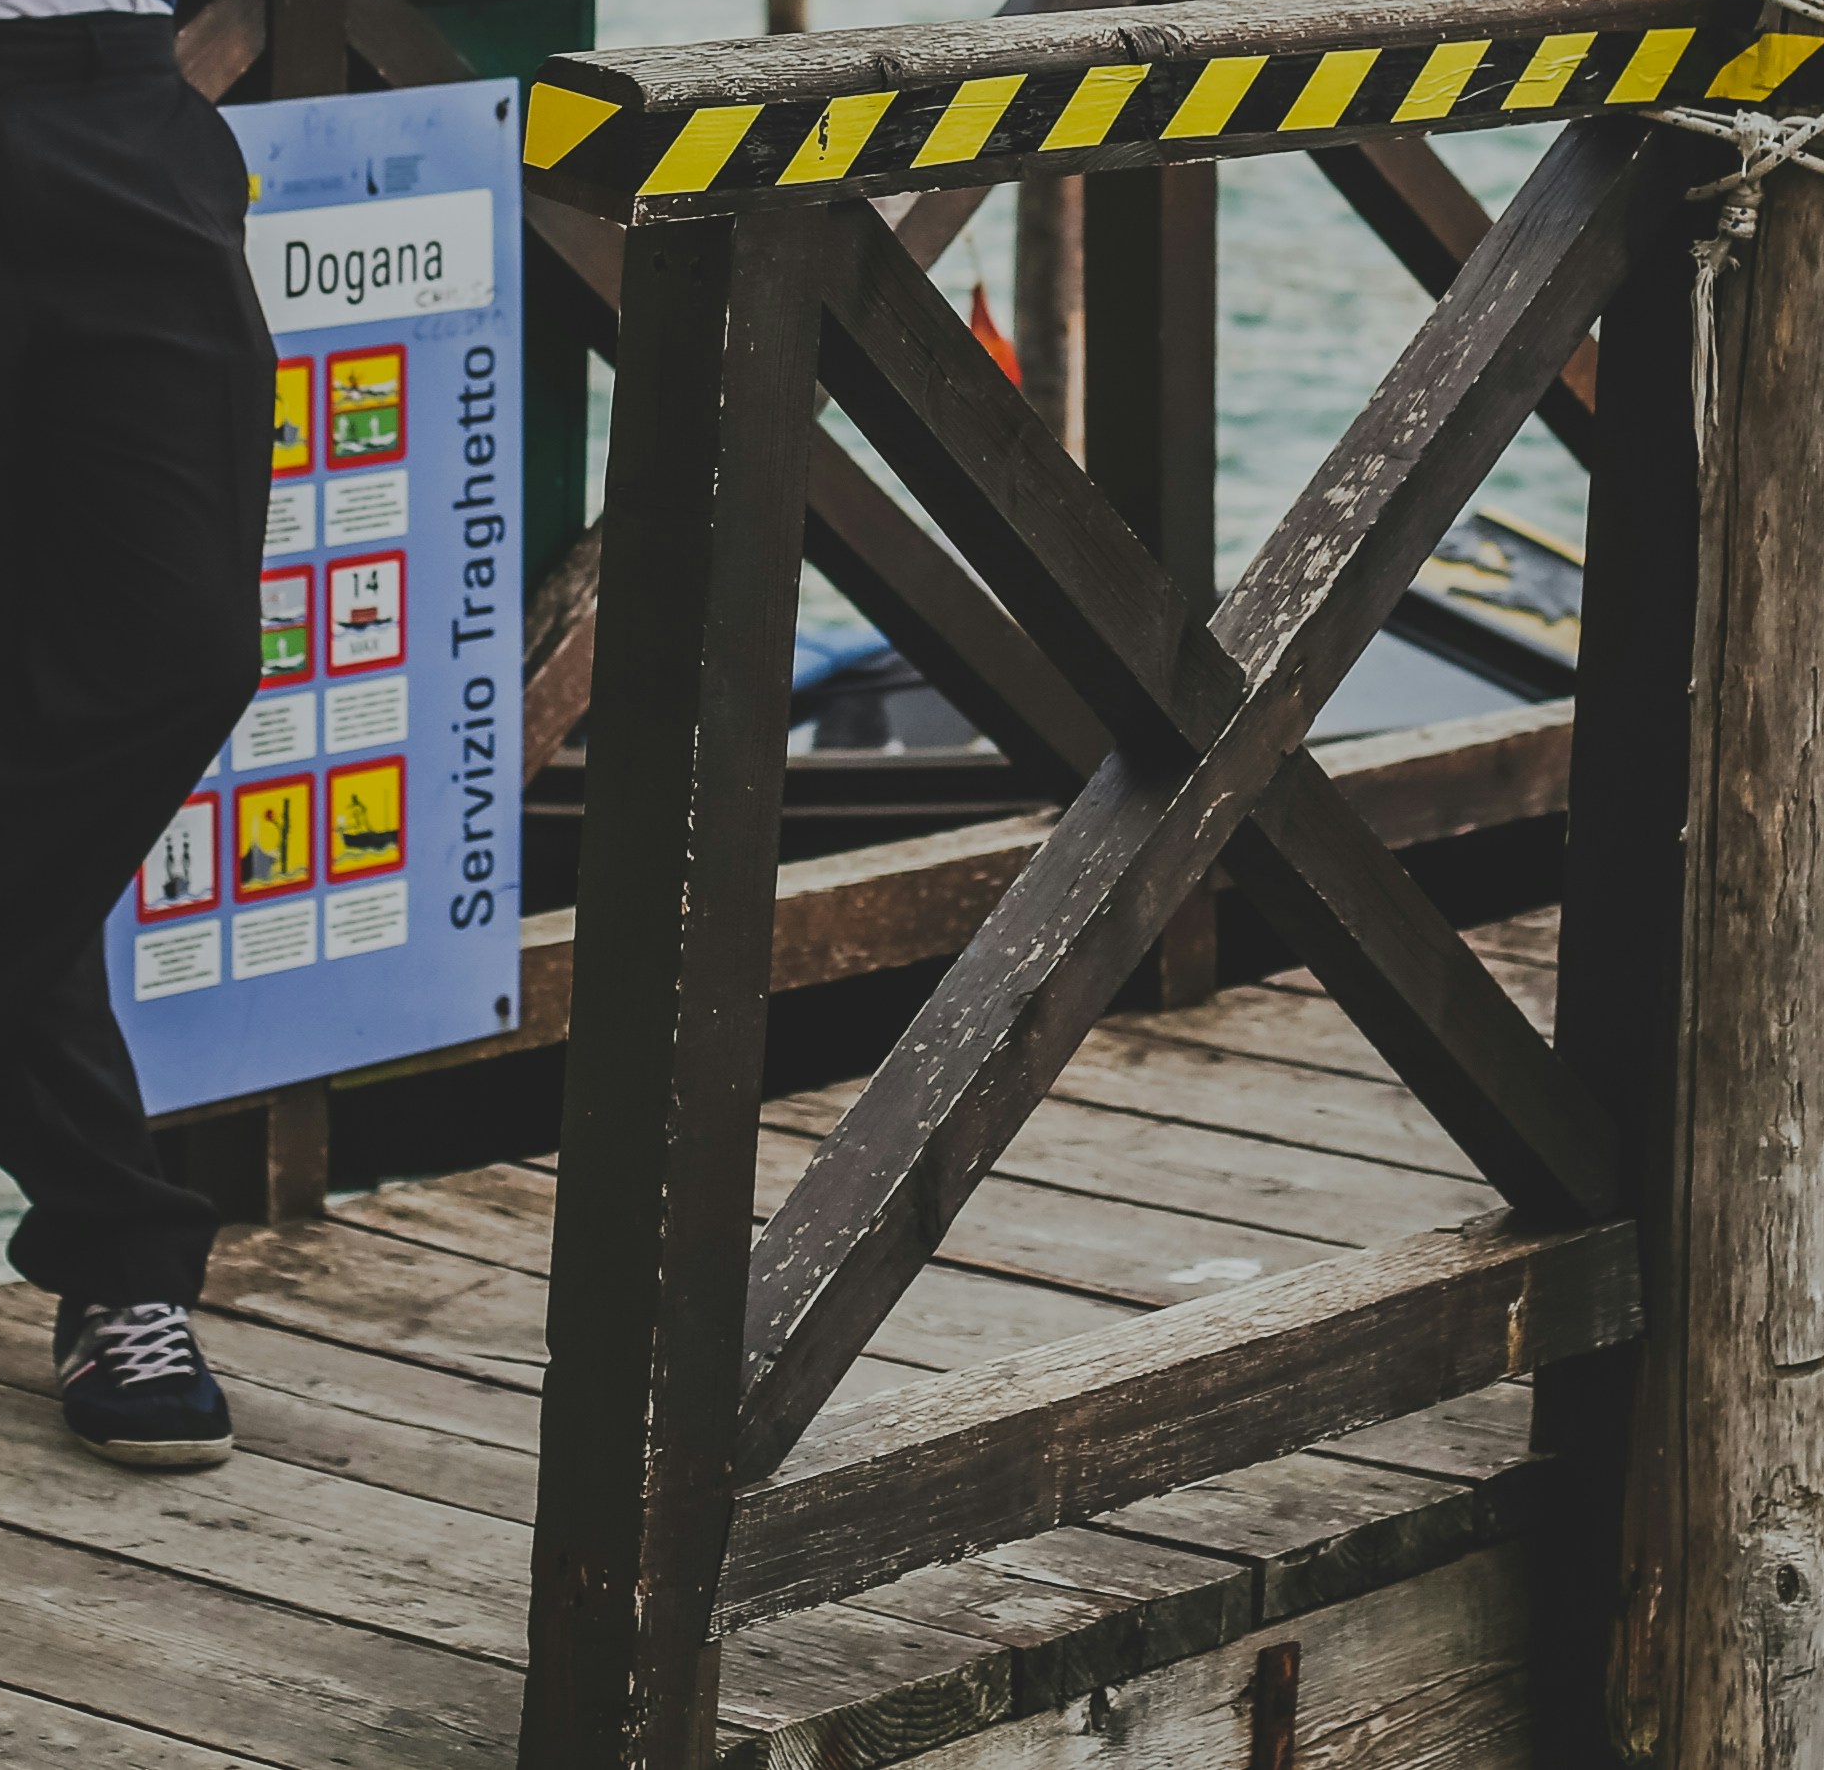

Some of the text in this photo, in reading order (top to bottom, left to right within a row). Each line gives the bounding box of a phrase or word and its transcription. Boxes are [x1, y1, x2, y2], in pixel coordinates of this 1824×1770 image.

[285, 240, 443, 306] Dogana
[450, 344, 505, 661] Traghetto
[352, 570, 380, 599] 14
[450, 675, 497, 931] Servizio
